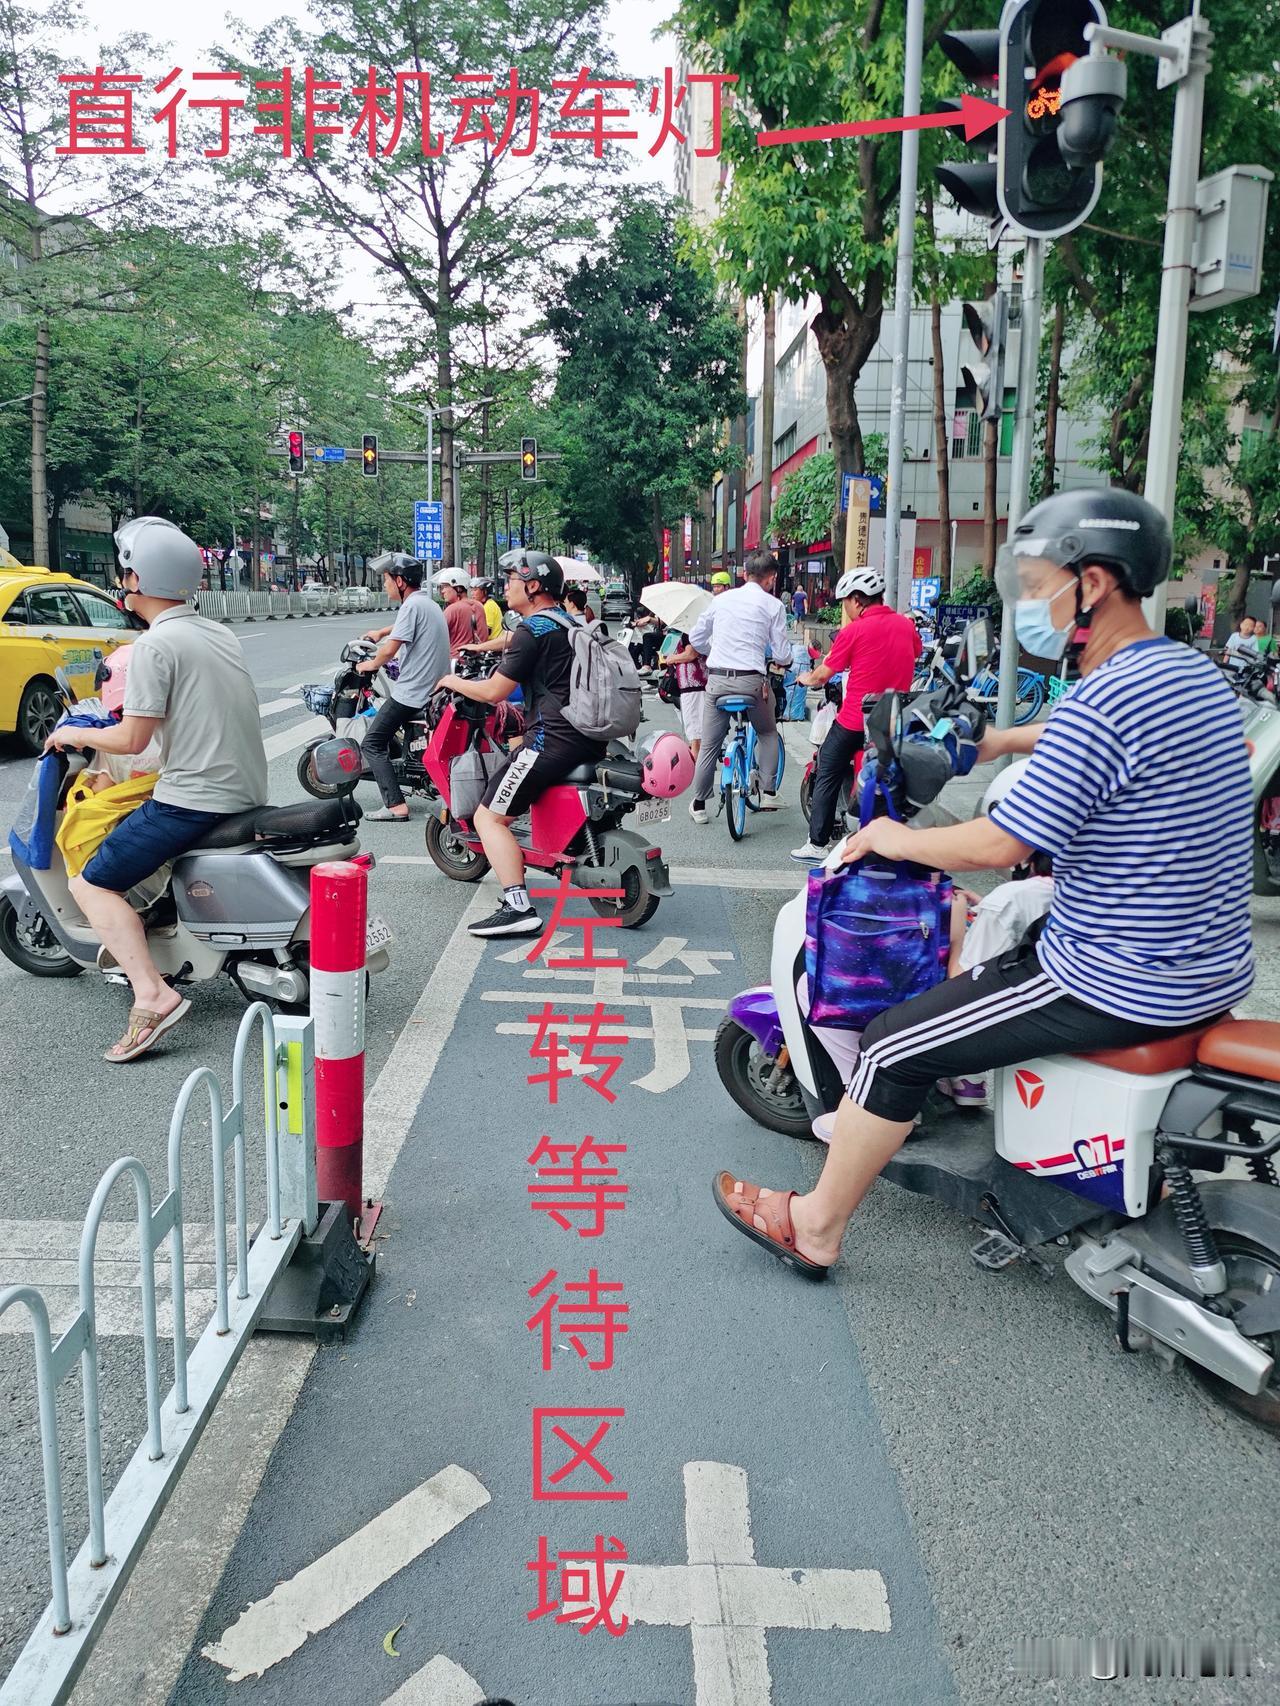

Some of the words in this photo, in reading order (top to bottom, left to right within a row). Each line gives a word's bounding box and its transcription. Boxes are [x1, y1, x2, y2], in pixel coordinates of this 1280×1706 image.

[920, 585, 937, 607] P
[639, 806, 668, 822] GB0255
[366, 926, 392, 947] 2552
